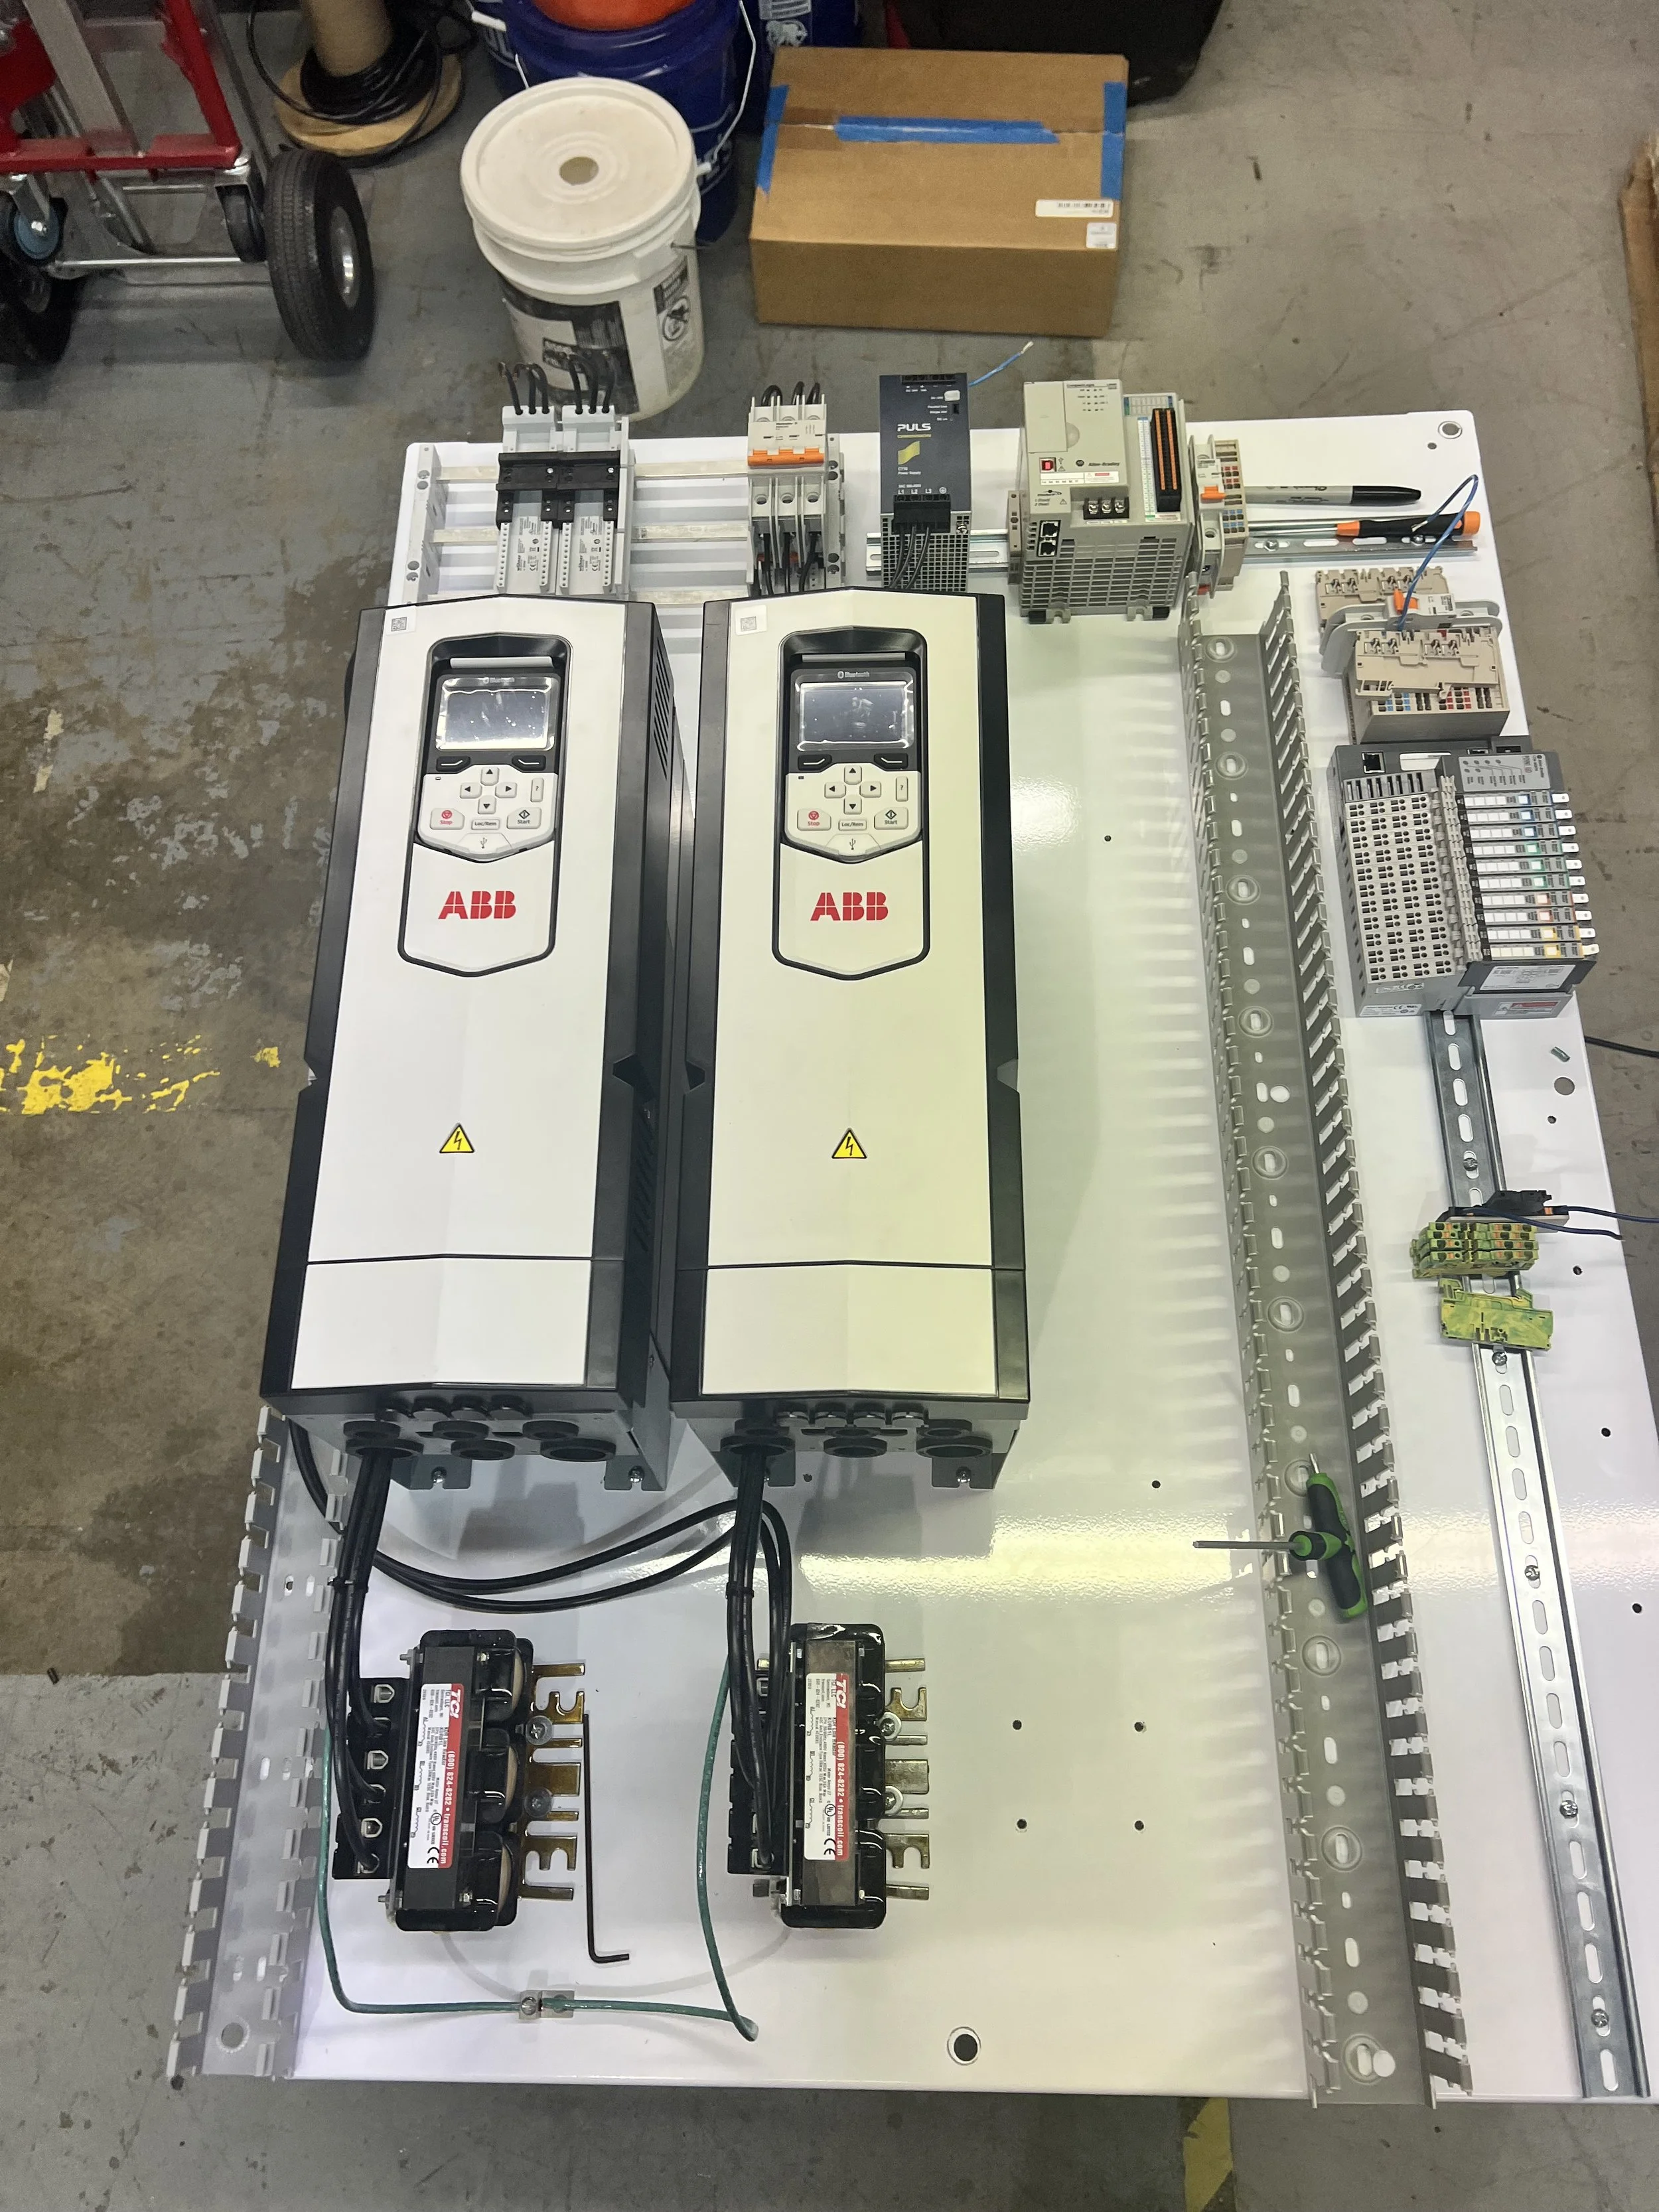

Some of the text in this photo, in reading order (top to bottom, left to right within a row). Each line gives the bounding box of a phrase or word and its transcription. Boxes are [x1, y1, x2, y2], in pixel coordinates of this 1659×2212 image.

[897, 423, 932, 431] PULS
[438, 890, 517, 920] ABB
[810, 892, 889, 921] ABB
[450, 1689, 461, 1719] TCI
[836, 1679, 846, 1709] TCI
[836, 1741, 845, 1761] (800)
[837, 1763, 845, 1797] 824-8282
[440, 1750, 456, 1864] (800) 824-8282 transcoil.com
